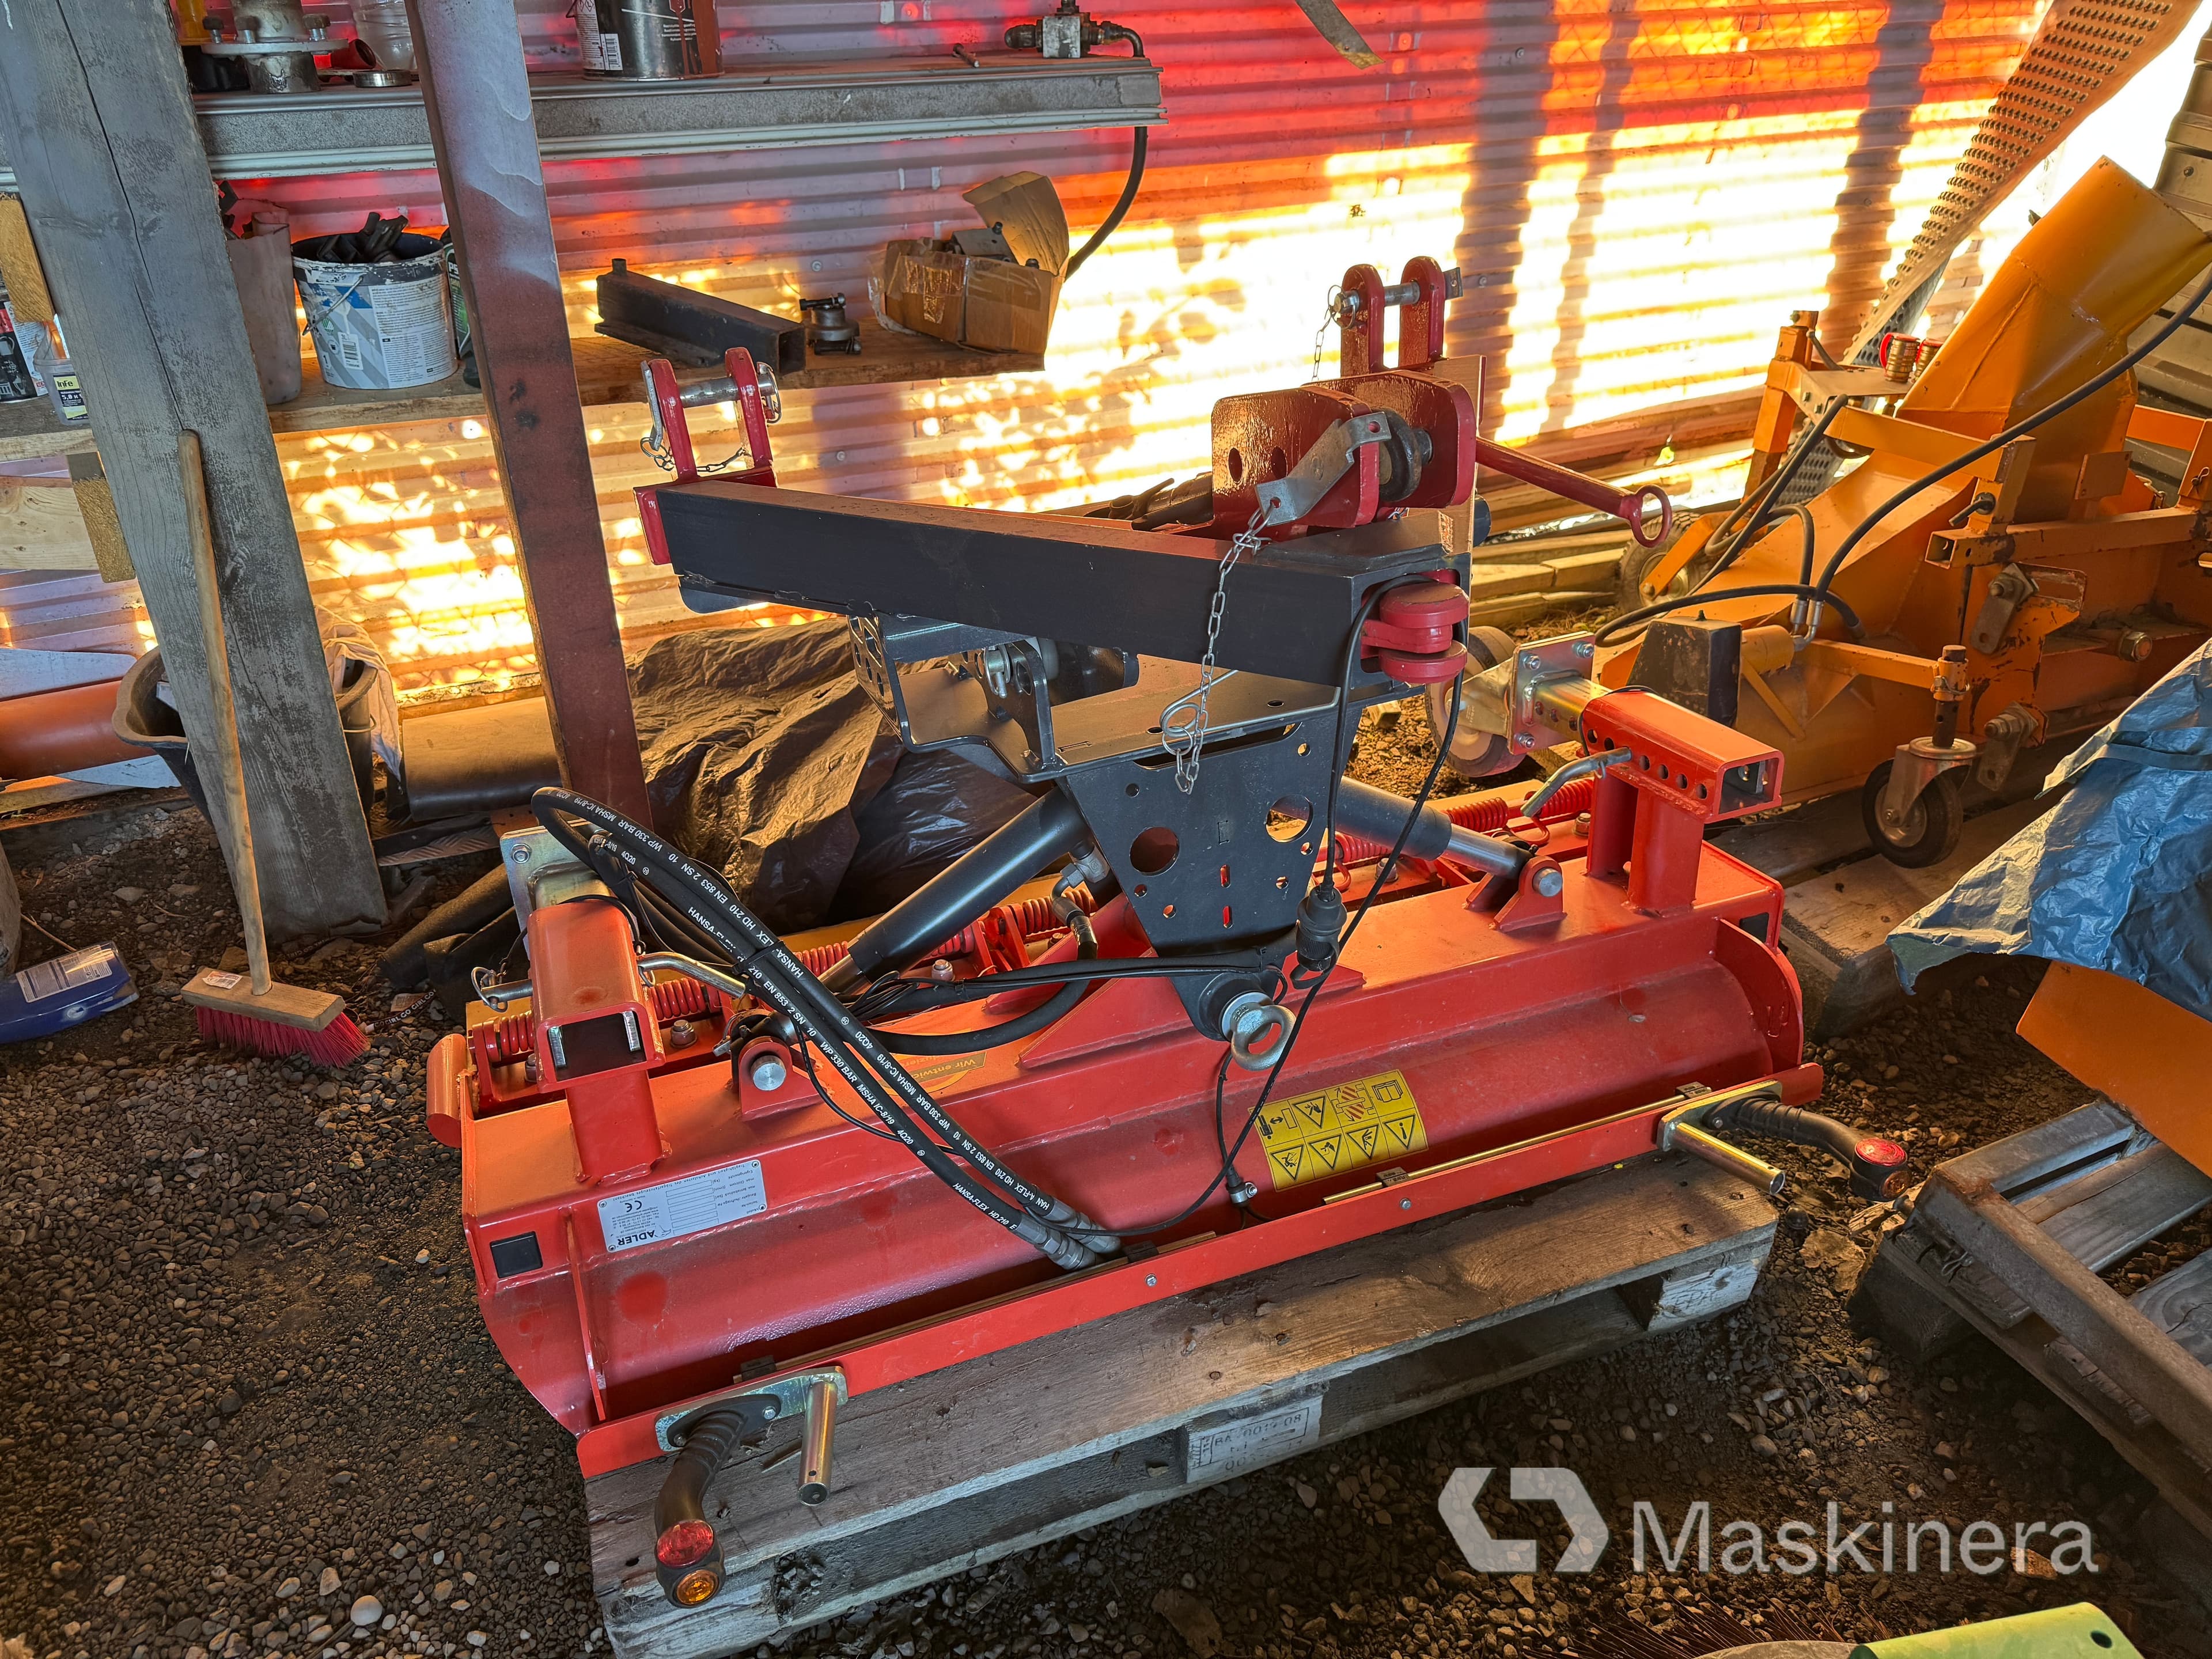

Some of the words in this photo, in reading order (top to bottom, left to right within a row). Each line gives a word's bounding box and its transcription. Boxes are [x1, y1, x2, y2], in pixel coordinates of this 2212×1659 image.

[595, 806, 617, 822] MSHA
[618, 819, 635, 834] BAR
[635, 830, 650, 842] 330
[647, 840, 663, 852] WP
[668, 853, 679, 863] 10
[680, 863, 695, 876] SN
[692, 872, 702, 881] 2
[700, 879, 716, 893] 853
[714, 892, 728, 904] EN
[729, 904, 745, 918] 210
[742, 917, 756, 930] HD
[622, 851, 636, 865] 4Q20
[748, 966, 762, 980] 210
[763, 981, 777, 994] EN
[774, 990, 789, 1006] 853
[793, 1012, 806, 1025] SN
[807, 1027, 816, 1037] 10
[820, 1041, 832, 1056] WP
[831, 1054, 844, 1068] 330
[840, 1066, 858, 1083] BAR
[856, 1084, 877, 1105] MSHA
[897, 1130, 914, 1145] 4Q20
[952, 1183, 990, 1211] HANSA-FLEX
[988, 1210, 999, 1220] HD
[997, 1216, 1010, 1225] 210
[855, 1031, 873, 1050] 4Q20
[955, 1059, 976, 1069] Wir
[897, 1073, 916, 1096] MSHA
[916, 1094, 931, 1111] BAR
[929, 1108, 941, 1120] 330
[938, 1119, 950, 1130] WP
[953, 1131, 961, 1141] 10
[961, 1139, 972, 1151] SN
[975, 1152, 987, 1164] 853
[984, 1161, 995, 1171] EN
[995, 1168, 1006, 1179] 210
[1004, 1176, 1014, 1187] HD
[617, 1230, 656, 1245] ADLER
